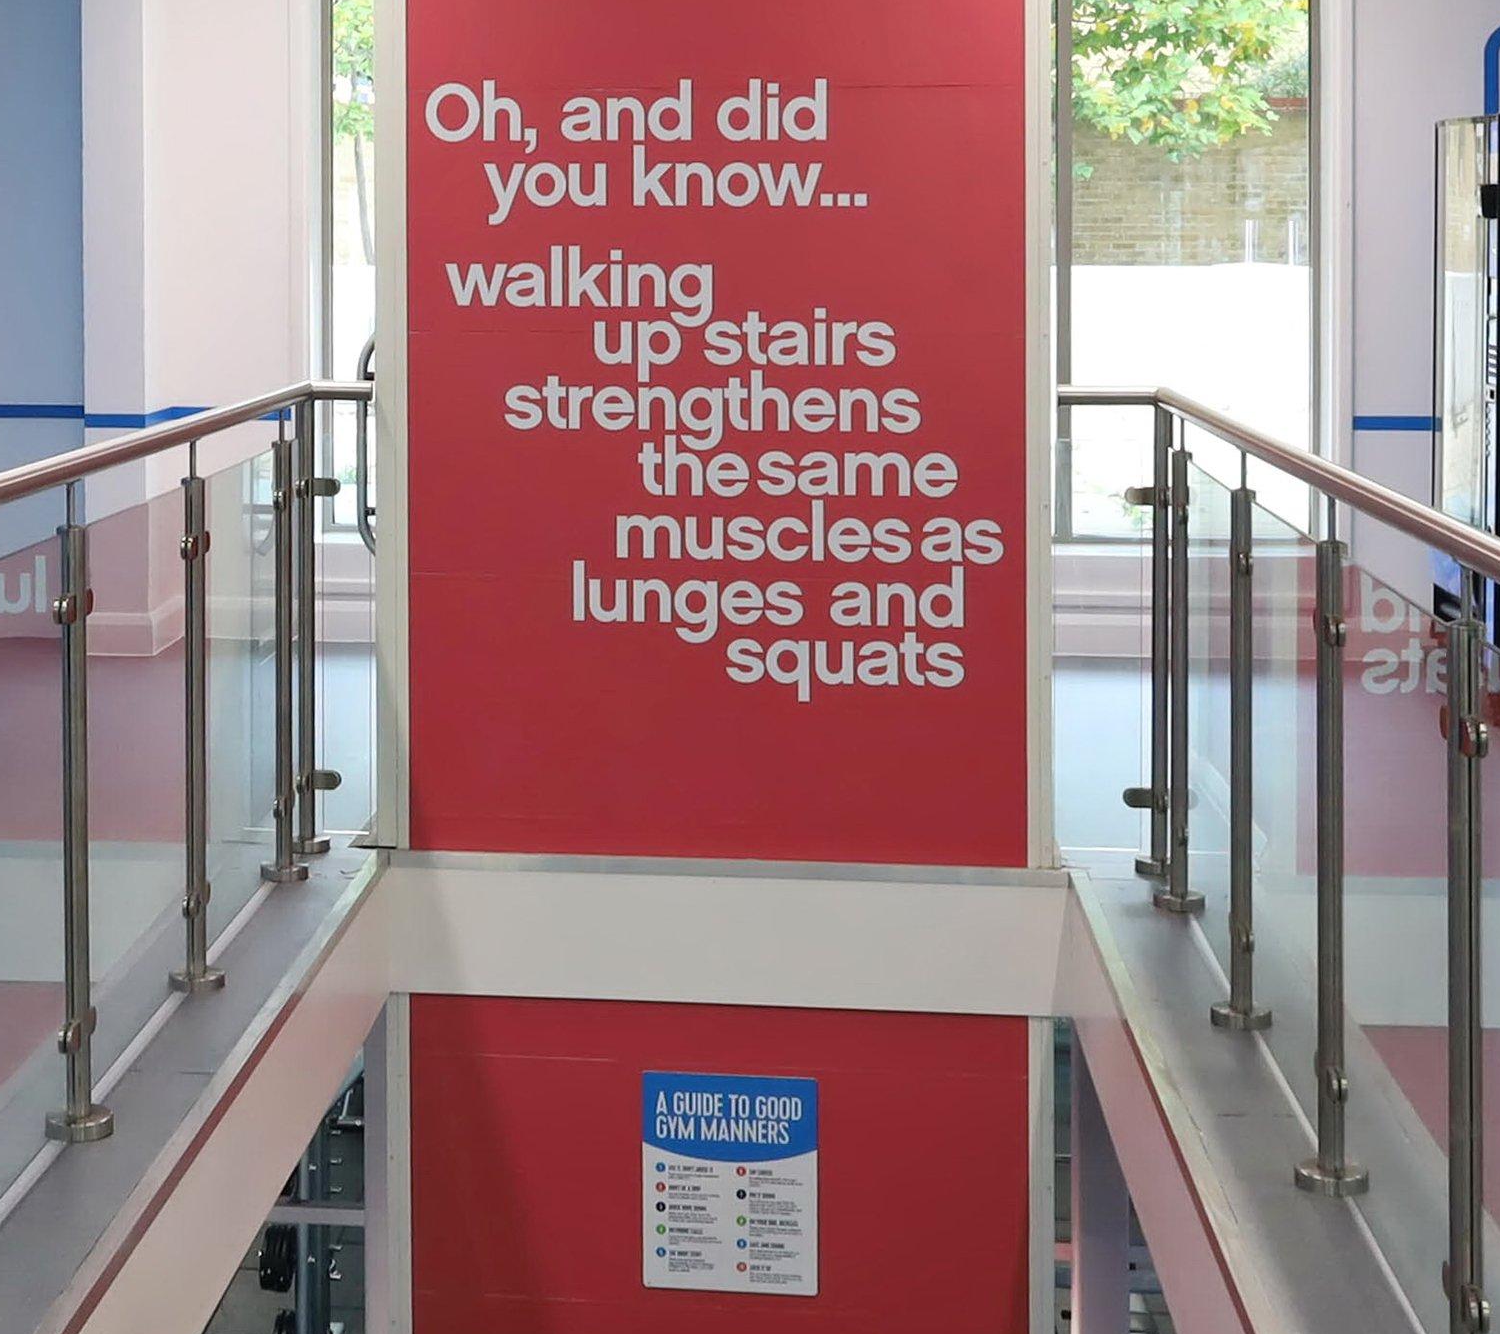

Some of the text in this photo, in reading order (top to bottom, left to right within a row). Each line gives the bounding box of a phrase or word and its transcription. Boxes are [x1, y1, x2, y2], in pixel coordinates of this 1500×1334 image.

[424, 78, 828, 154] Oh, and did
[483, 144, 868, 226] you know...
[444, 245, 713, 328] walking
[593, 307, 896, 383] up stairs
[504, 369, 921, 451] strengthens
[637, 434, 959, 498] the same
[616, 499, 1004, 565] muscles as
[573, 560, 964, 644] lunges and
[725, 631, 965, 702] squats
[655, 1091, 802, 1121] A GUIDE TO GOOD
[655, 1115, 790, 1145] GYM MANNERS
